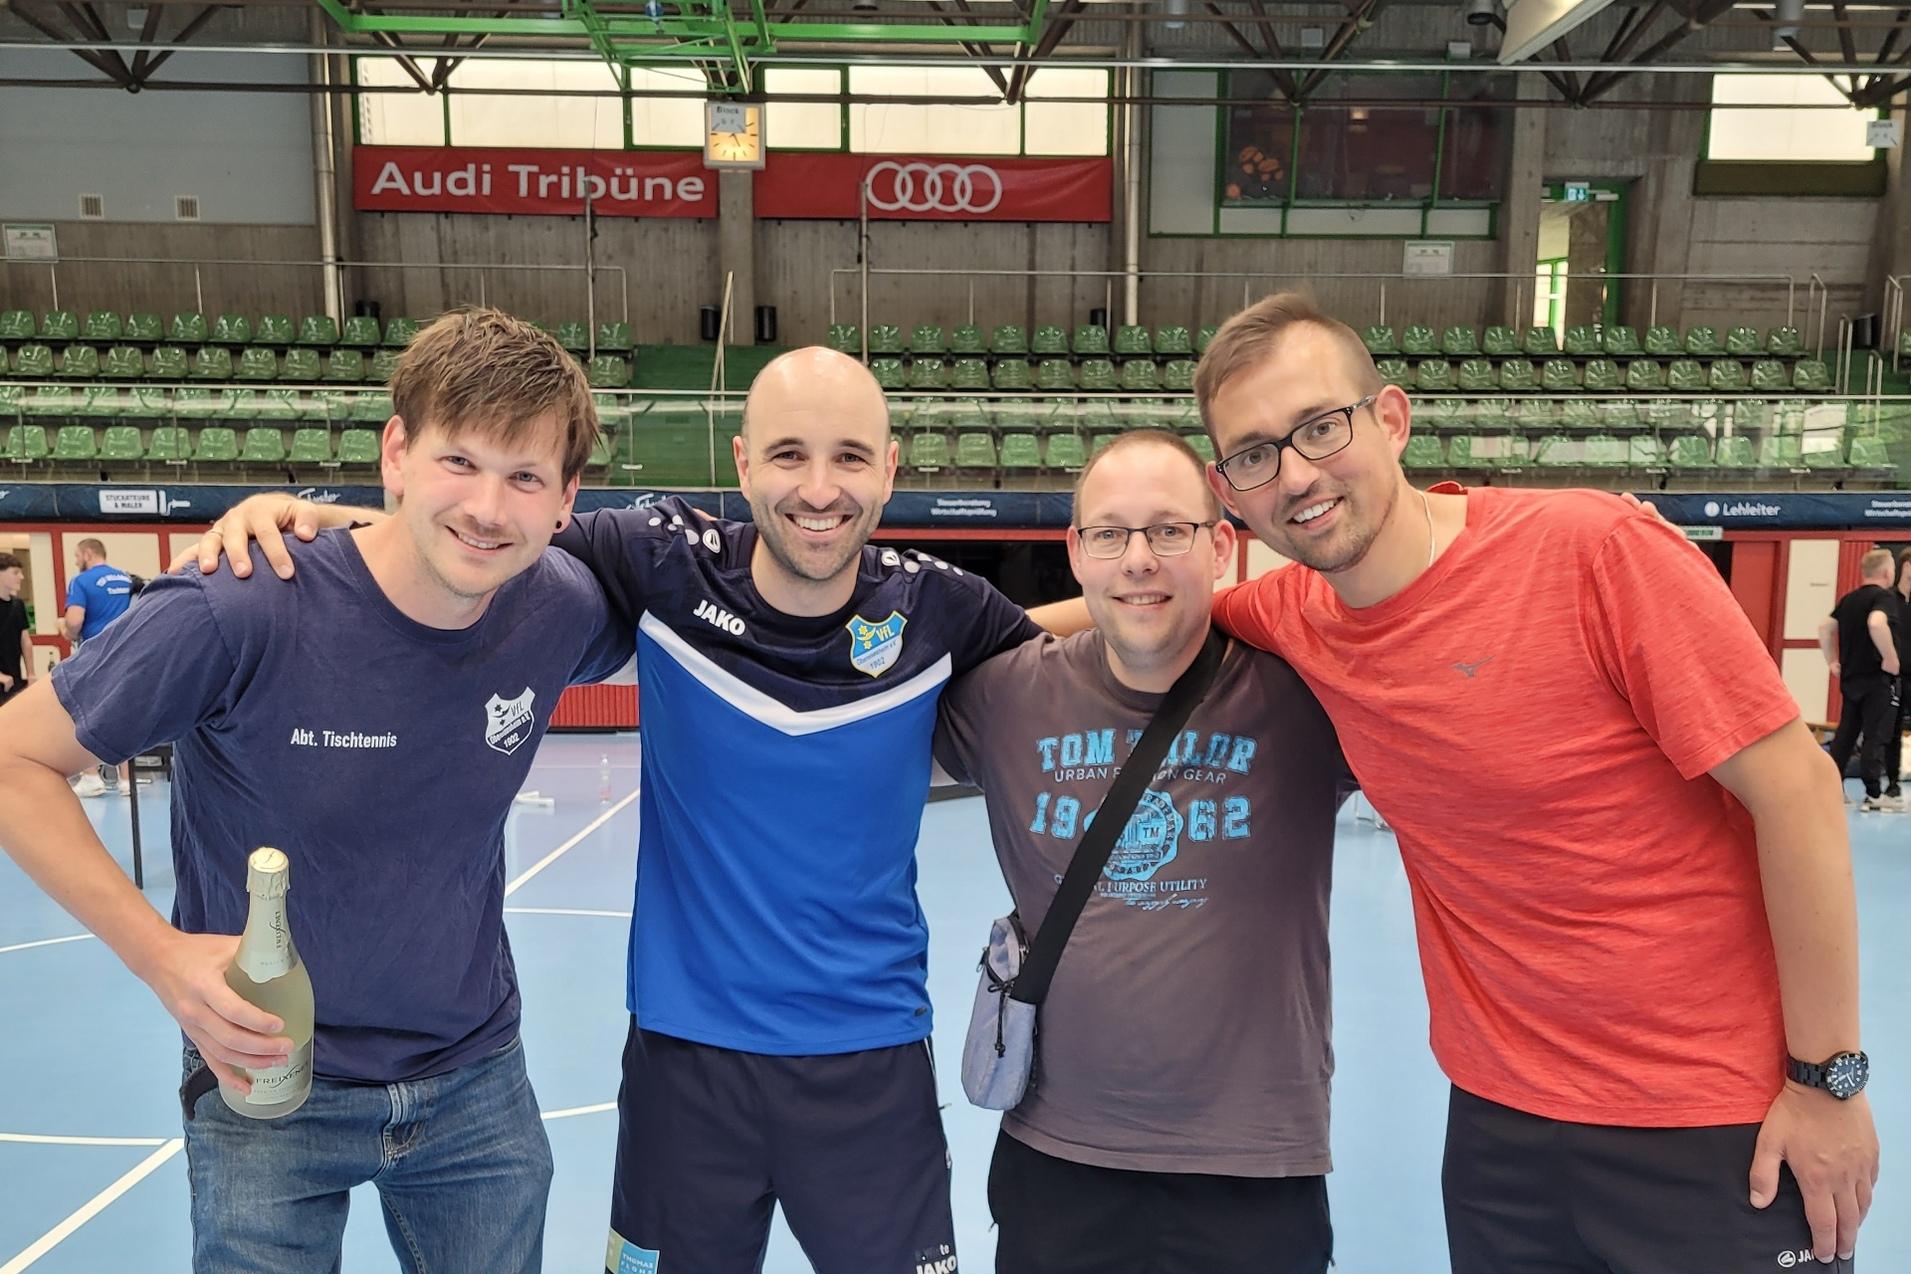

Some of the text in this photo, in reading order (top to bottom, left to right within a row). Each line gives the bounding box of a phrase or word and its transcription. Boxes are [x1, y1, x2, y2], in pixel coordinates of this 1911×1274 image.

[371, 161, 705, 202] Audi Tribüne
[1723, 501, 1782, 517] Lehleiter
[693, 599, 746, 636] JAKO
[290, 728, 398, 748] Abt. Tischtennis
[1036, 728, 1258, 775] TOM ILOR
[1054, 767, 1107, 783] URBAN
[1183, 768, 1227, 784] GEAR
[1029, 791, 1252, 843] 19 62
[1160, 878, 1208, 892] UTILITY
[916, 1255, 958, 1274] JAKO
[1797, 1249, 1815, 1263] JA
